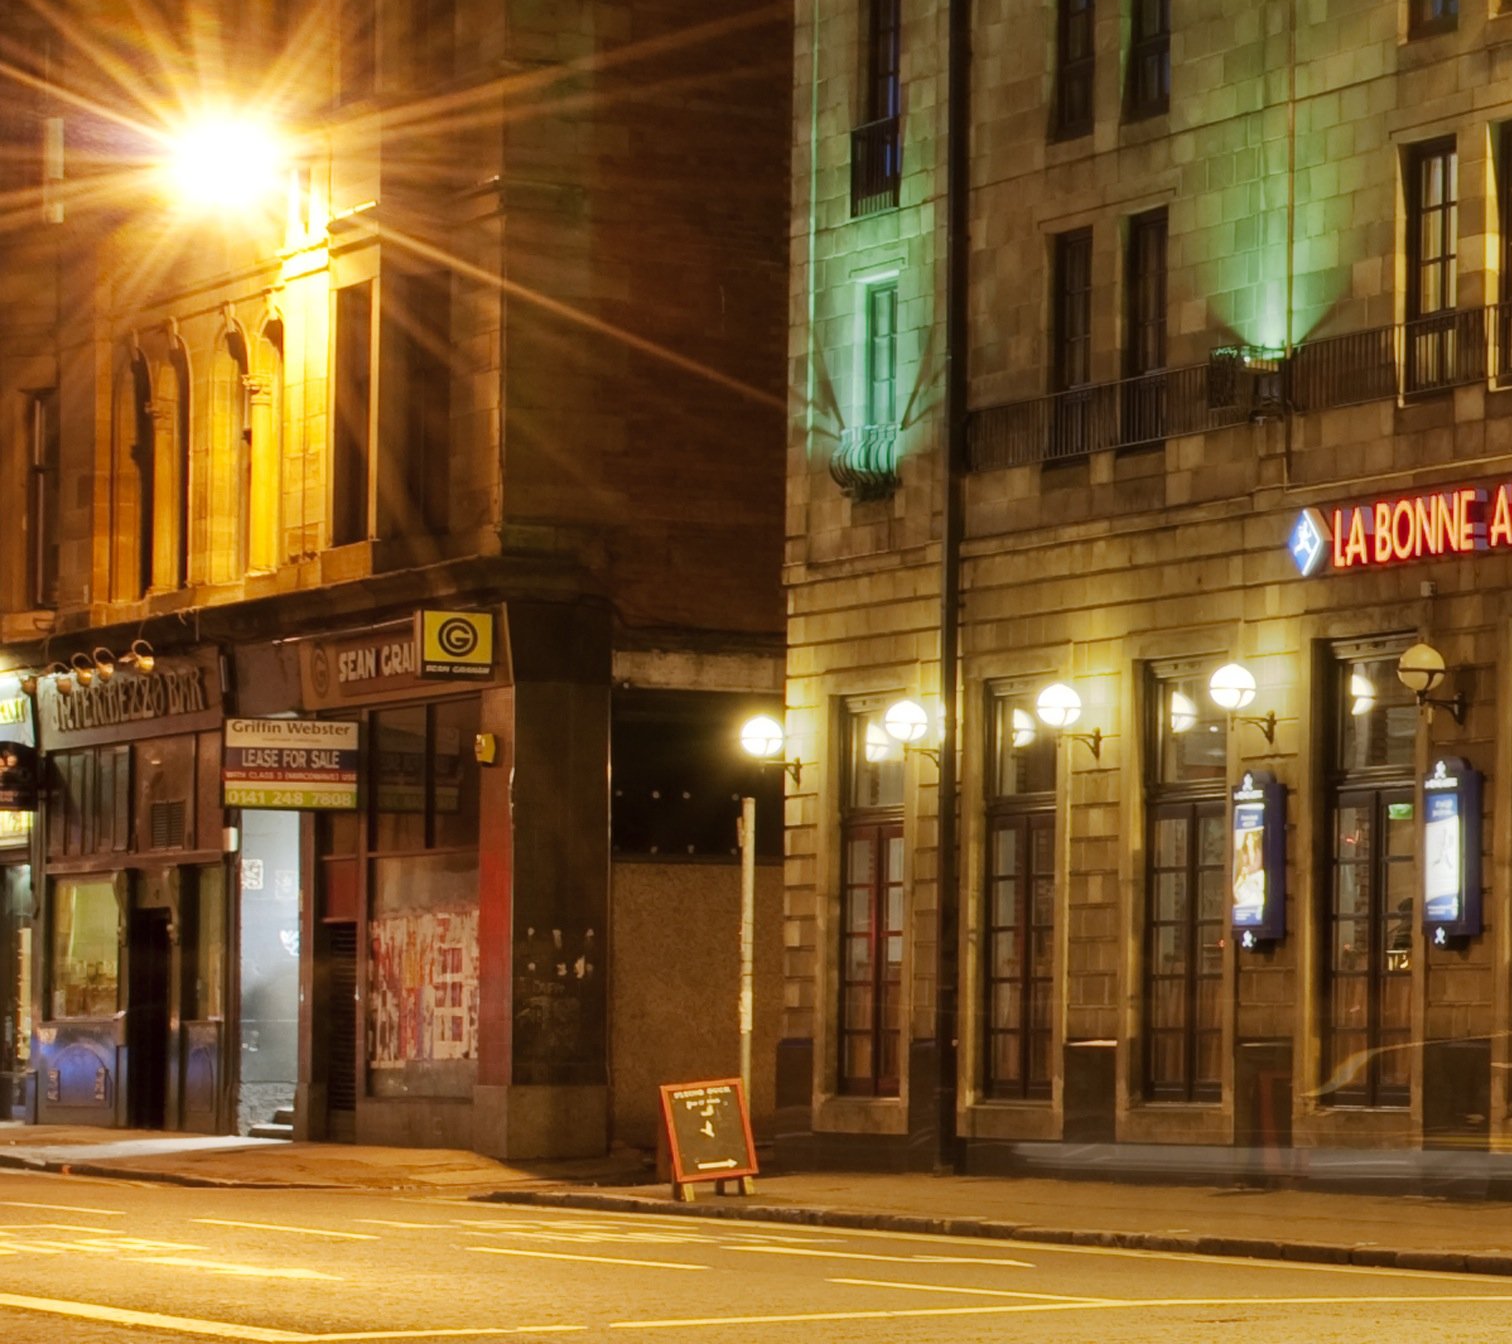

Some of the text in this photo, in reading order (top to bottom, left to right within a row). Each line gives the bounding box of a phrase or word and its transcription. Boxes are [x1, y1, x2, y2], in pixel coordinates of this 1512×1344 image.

[1334, 507, 1368, 567] LA
[1374, 489, 1476, 563] BONNE
[339, 648, 376, 683] SEAN
[426, 664, 450, 673] SEAN
[53, 674, 164, 732] INTERMEZZO
[166, 667, 205, 713] BAR
[231, 720, 351, 736] Griffin Webster
[242, 749, 340, 769] LEASE FOR SALE
[228, 790, 352, 807] 0141 248 7808
